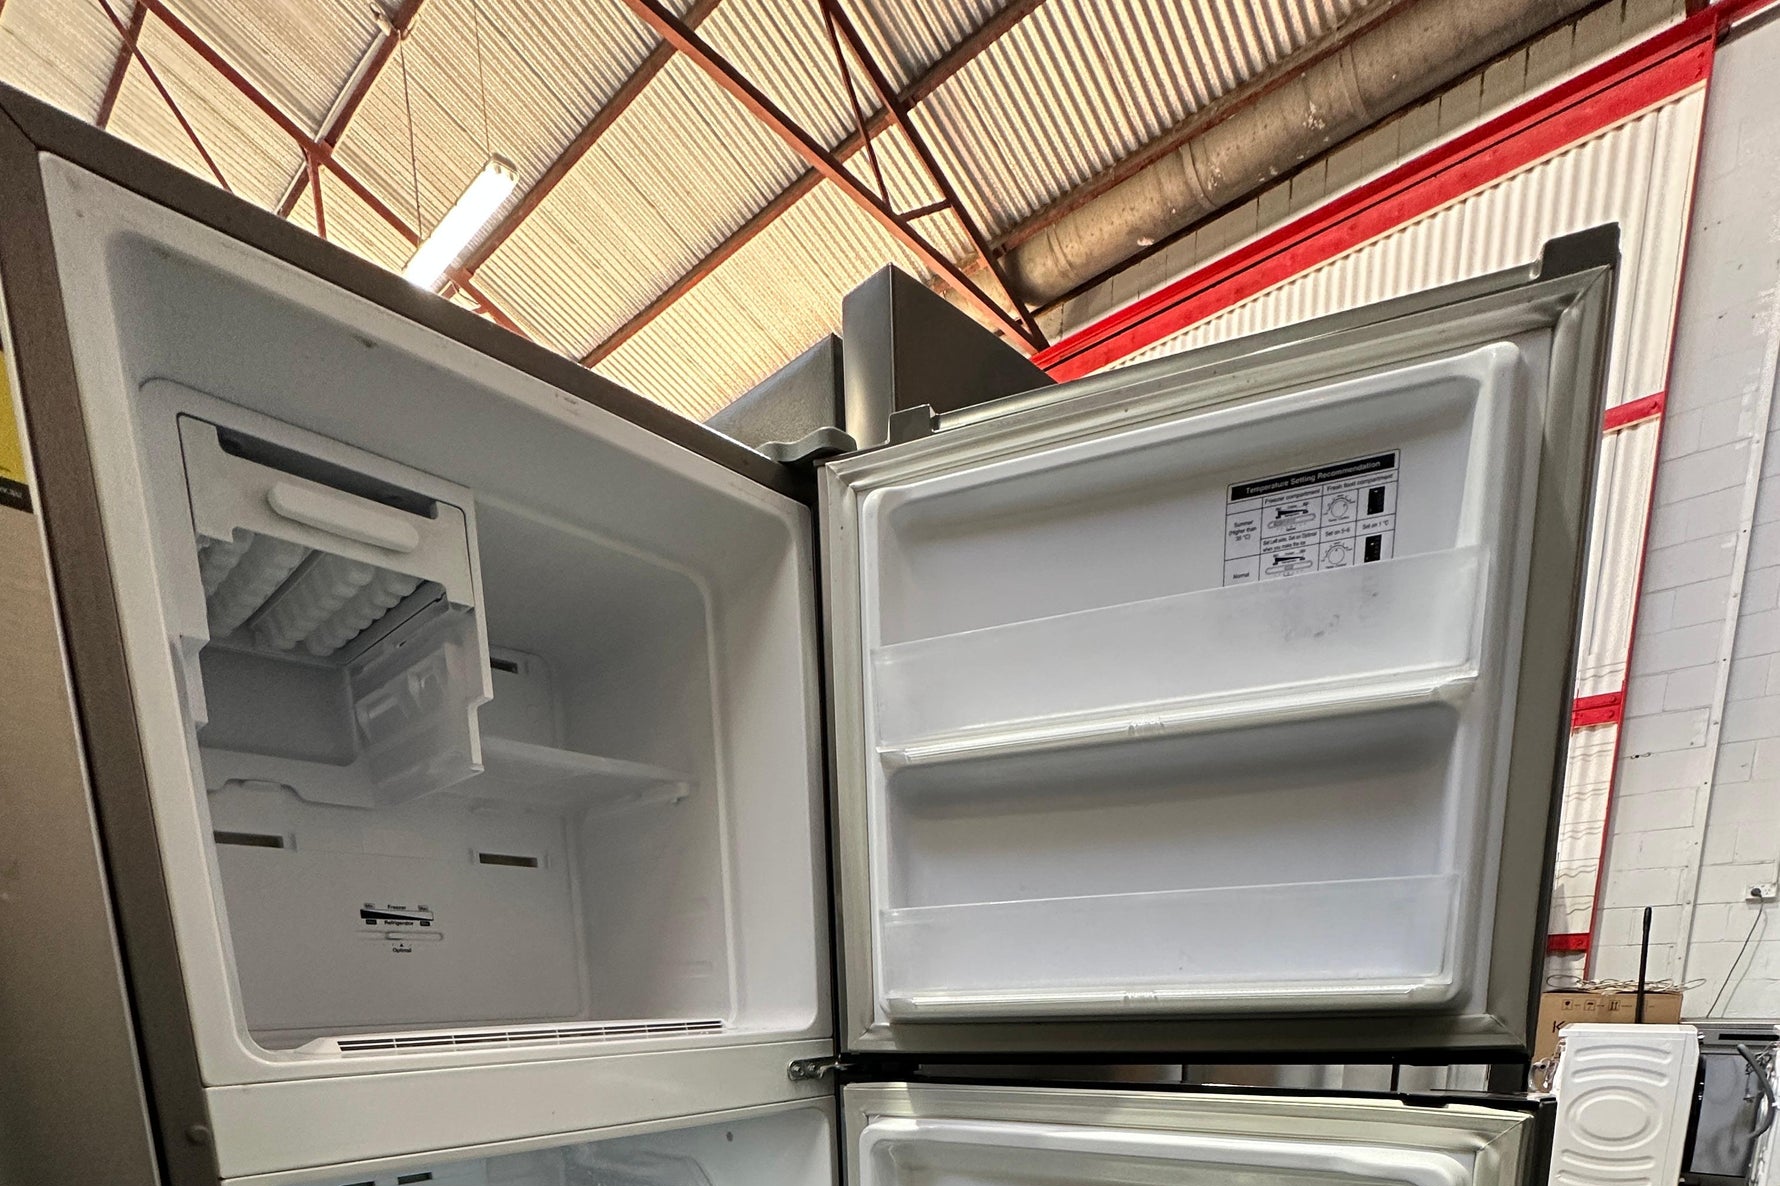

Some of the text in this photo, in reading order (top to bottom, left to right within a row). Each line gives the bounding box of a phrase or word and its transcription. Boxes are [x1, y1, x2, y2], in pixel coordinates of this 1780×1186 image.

[1246, 461, 1381, 494] Temperature Setting Recommendation
